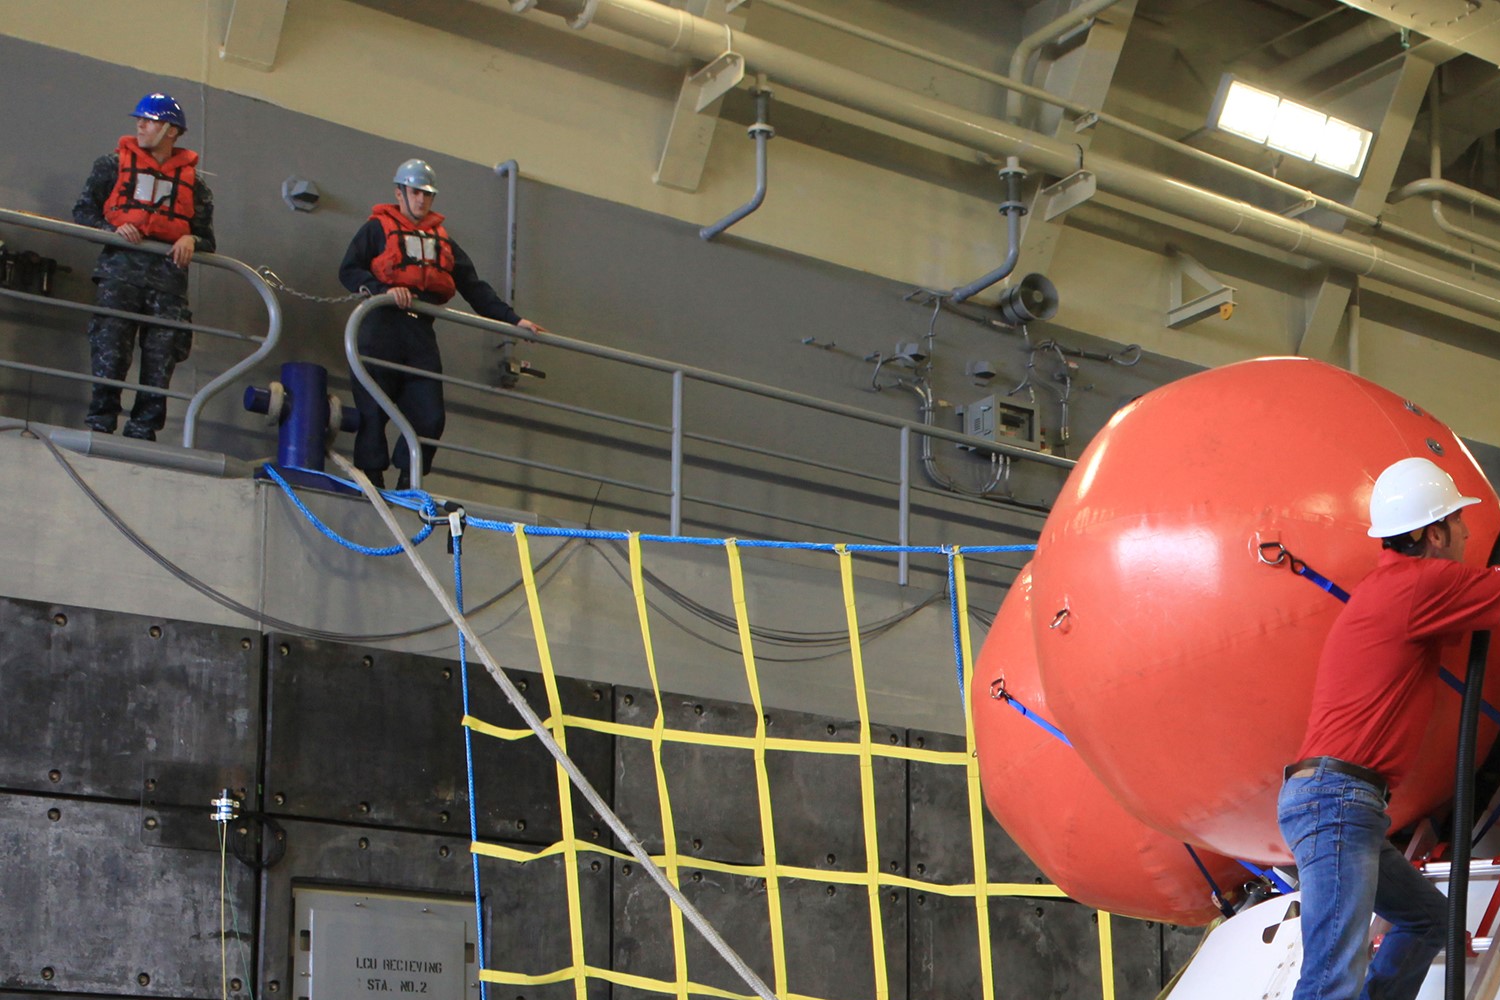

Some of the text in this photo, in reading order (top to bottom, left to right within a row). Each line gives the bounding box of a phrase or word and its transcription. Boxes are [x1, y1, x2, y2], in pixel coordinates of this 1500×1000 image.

[356, 957, 443, 974] LCU RECIEVING
[367, 979, 393, 992] STA.
